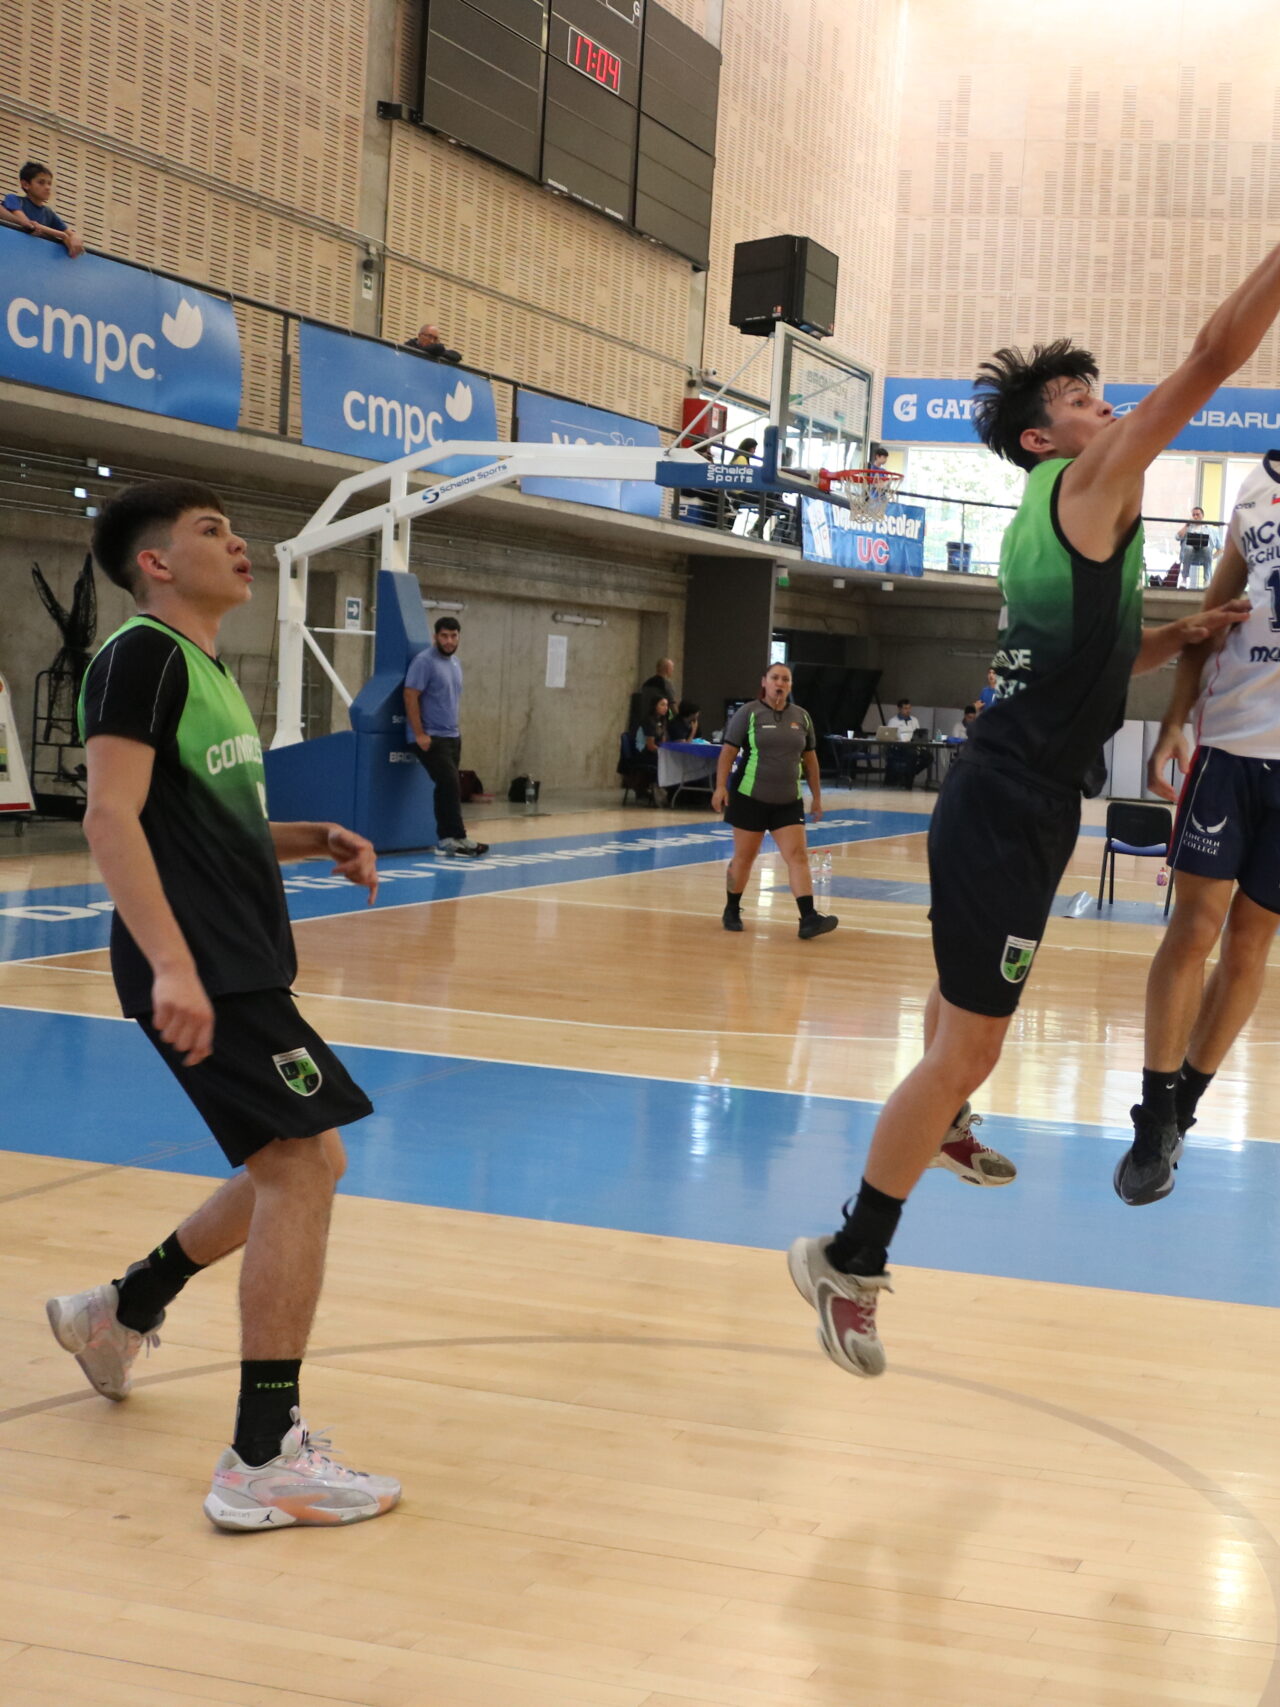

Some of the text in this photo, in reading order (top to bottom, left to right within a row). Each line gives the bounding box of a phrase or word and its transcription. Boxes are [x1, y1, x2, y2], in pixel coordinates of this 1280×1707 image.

[576, 36, 620, 89] 17:04
[7, 297, 156, 384] cmpc
[343, 390, 444, 454] cmpc
[439, 463, 508, 494] Schelde Sports
[706, 472, 753, 483] Sports
[707, 464, 754, 476] Schelde
[857, 535, 890, 565] UC
